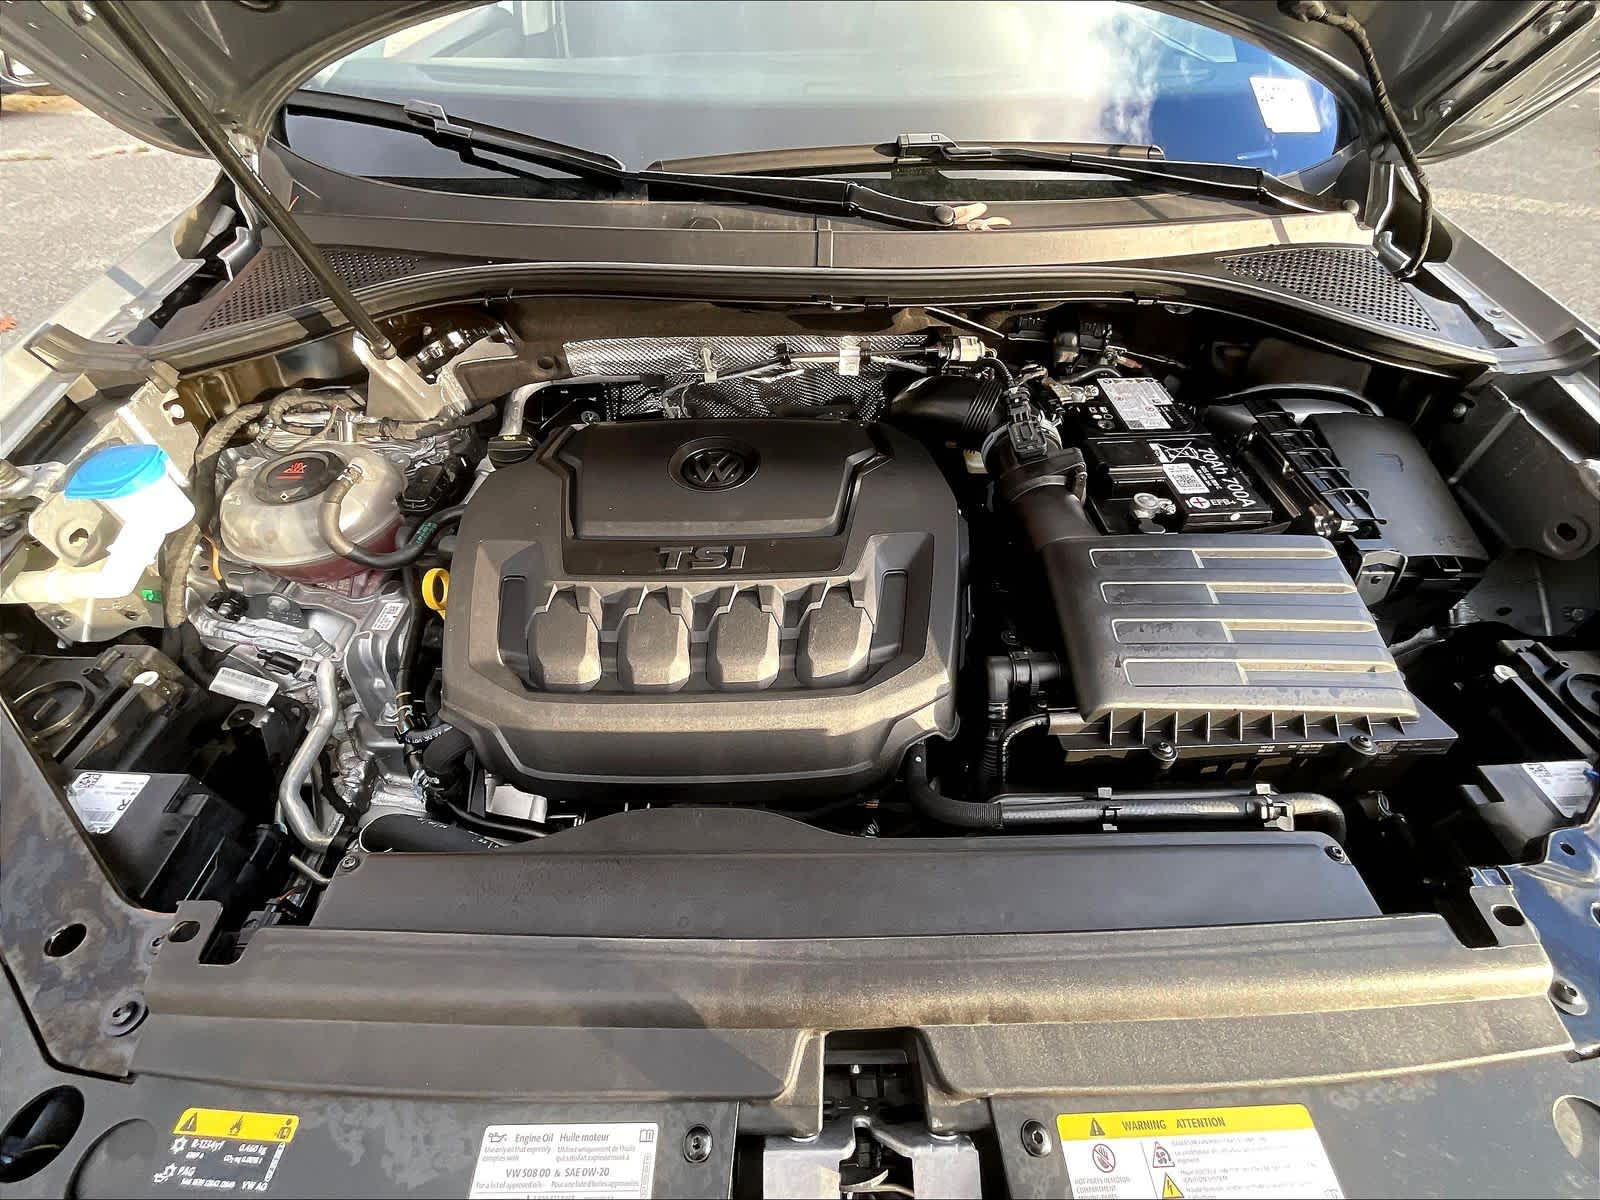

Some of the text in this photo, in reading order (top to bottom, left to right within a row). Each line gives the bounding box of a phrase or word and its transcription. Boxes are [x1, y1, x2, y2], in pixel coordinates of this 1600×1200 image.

[1198, 447, 1229, 475] 70Ah
[1221, 476, 1256, 508] 700A
[657, 545, 748, 570] TSI
[1122, 1116, 1226, 1131] WARNING ATTENTION
[514, 1132, 554, 1145] Engine Oil
[560, 1132, 610, 1142] Huile moteur
[506, 1168, 521, 1178] VW
[522, 1168, 538, 1178] 508
[539, 1168, 551, 1177] 00
[564, 1168, 581, 1178] SAE
[241, 1181, 255, 1190] VW
